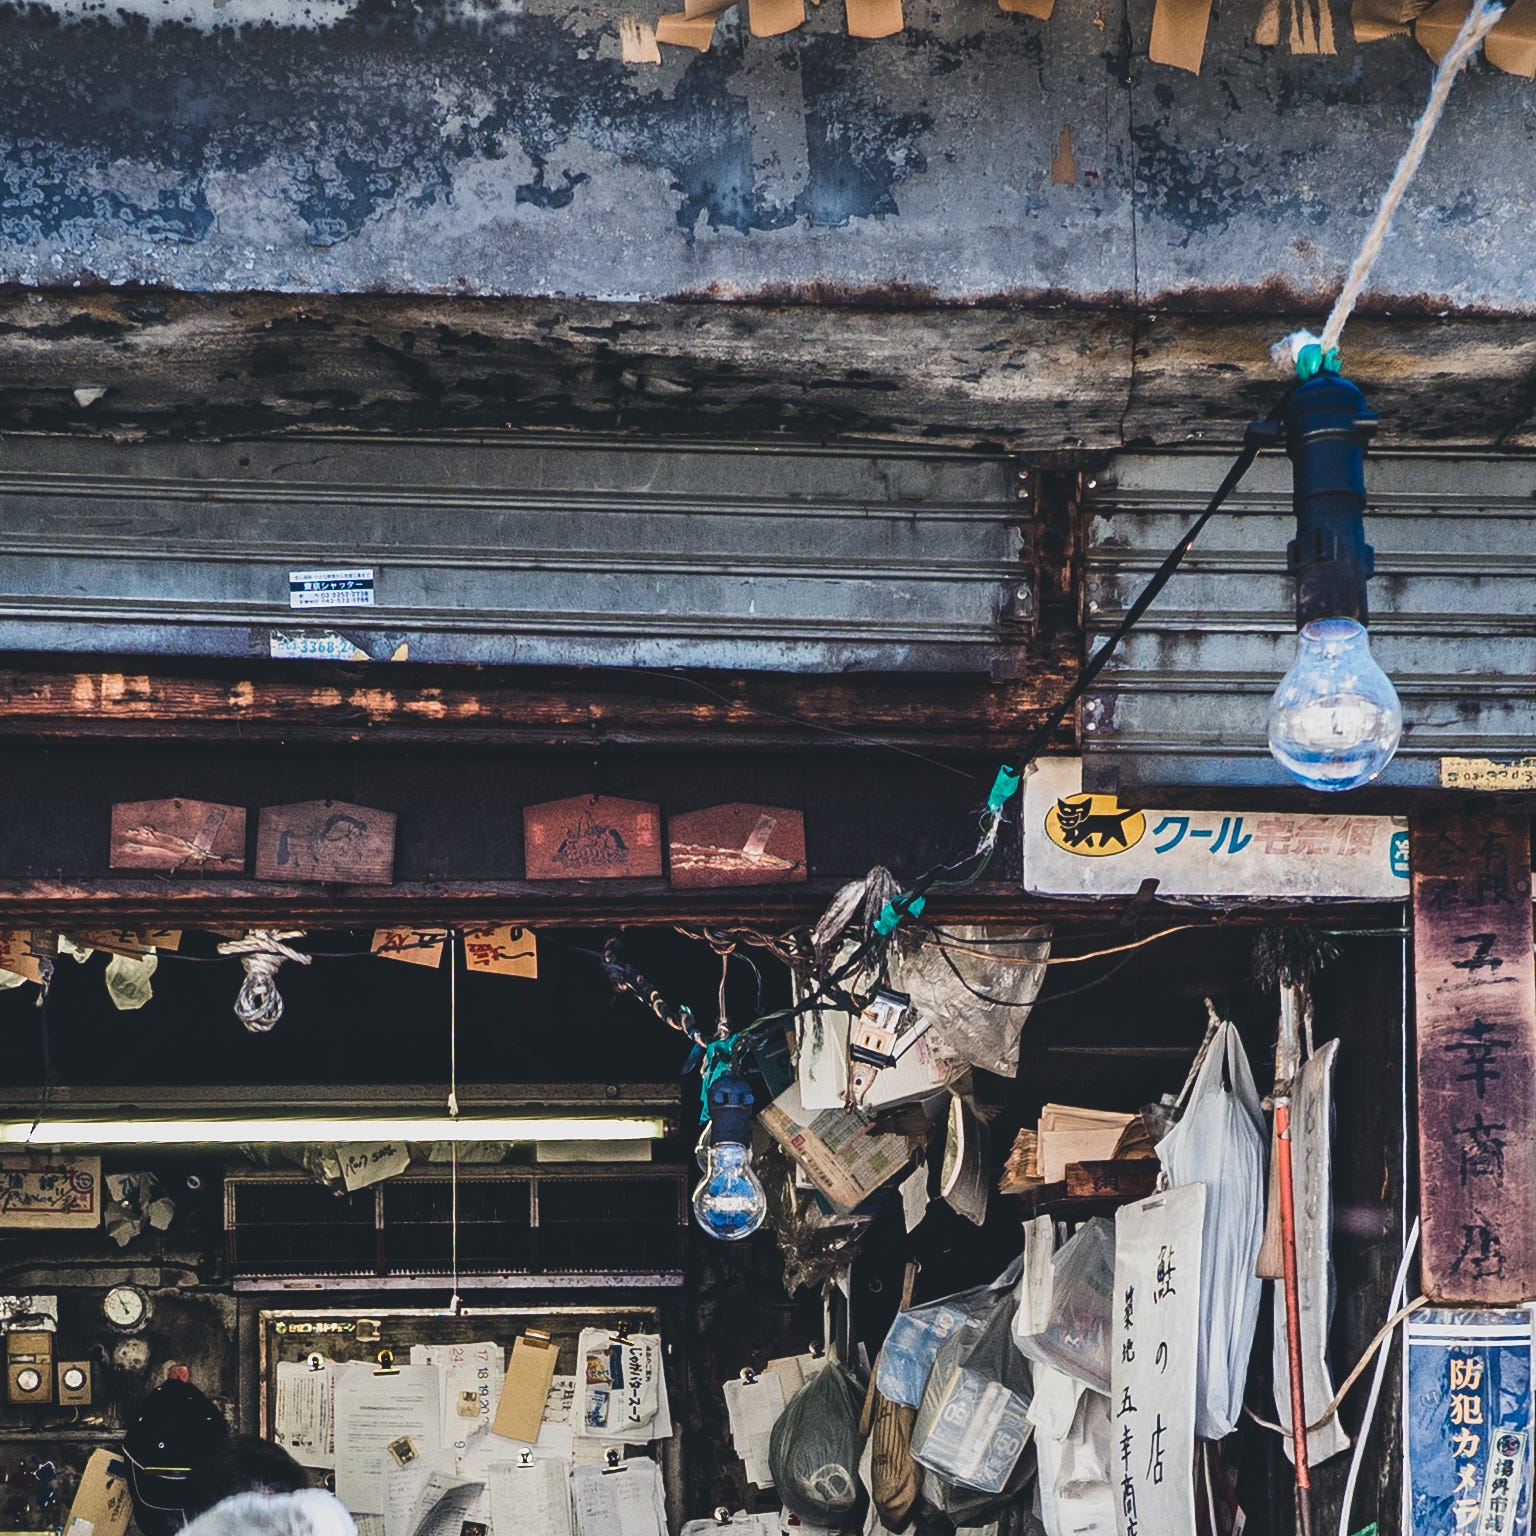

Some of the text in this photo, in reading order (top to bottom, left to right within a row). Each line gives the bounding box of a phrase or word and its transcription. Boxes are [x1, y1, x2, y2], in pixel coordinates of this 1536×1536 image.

[1153, 814, 1381, 856] クール宅急便
[477, 1366, 488, 1380] 18
